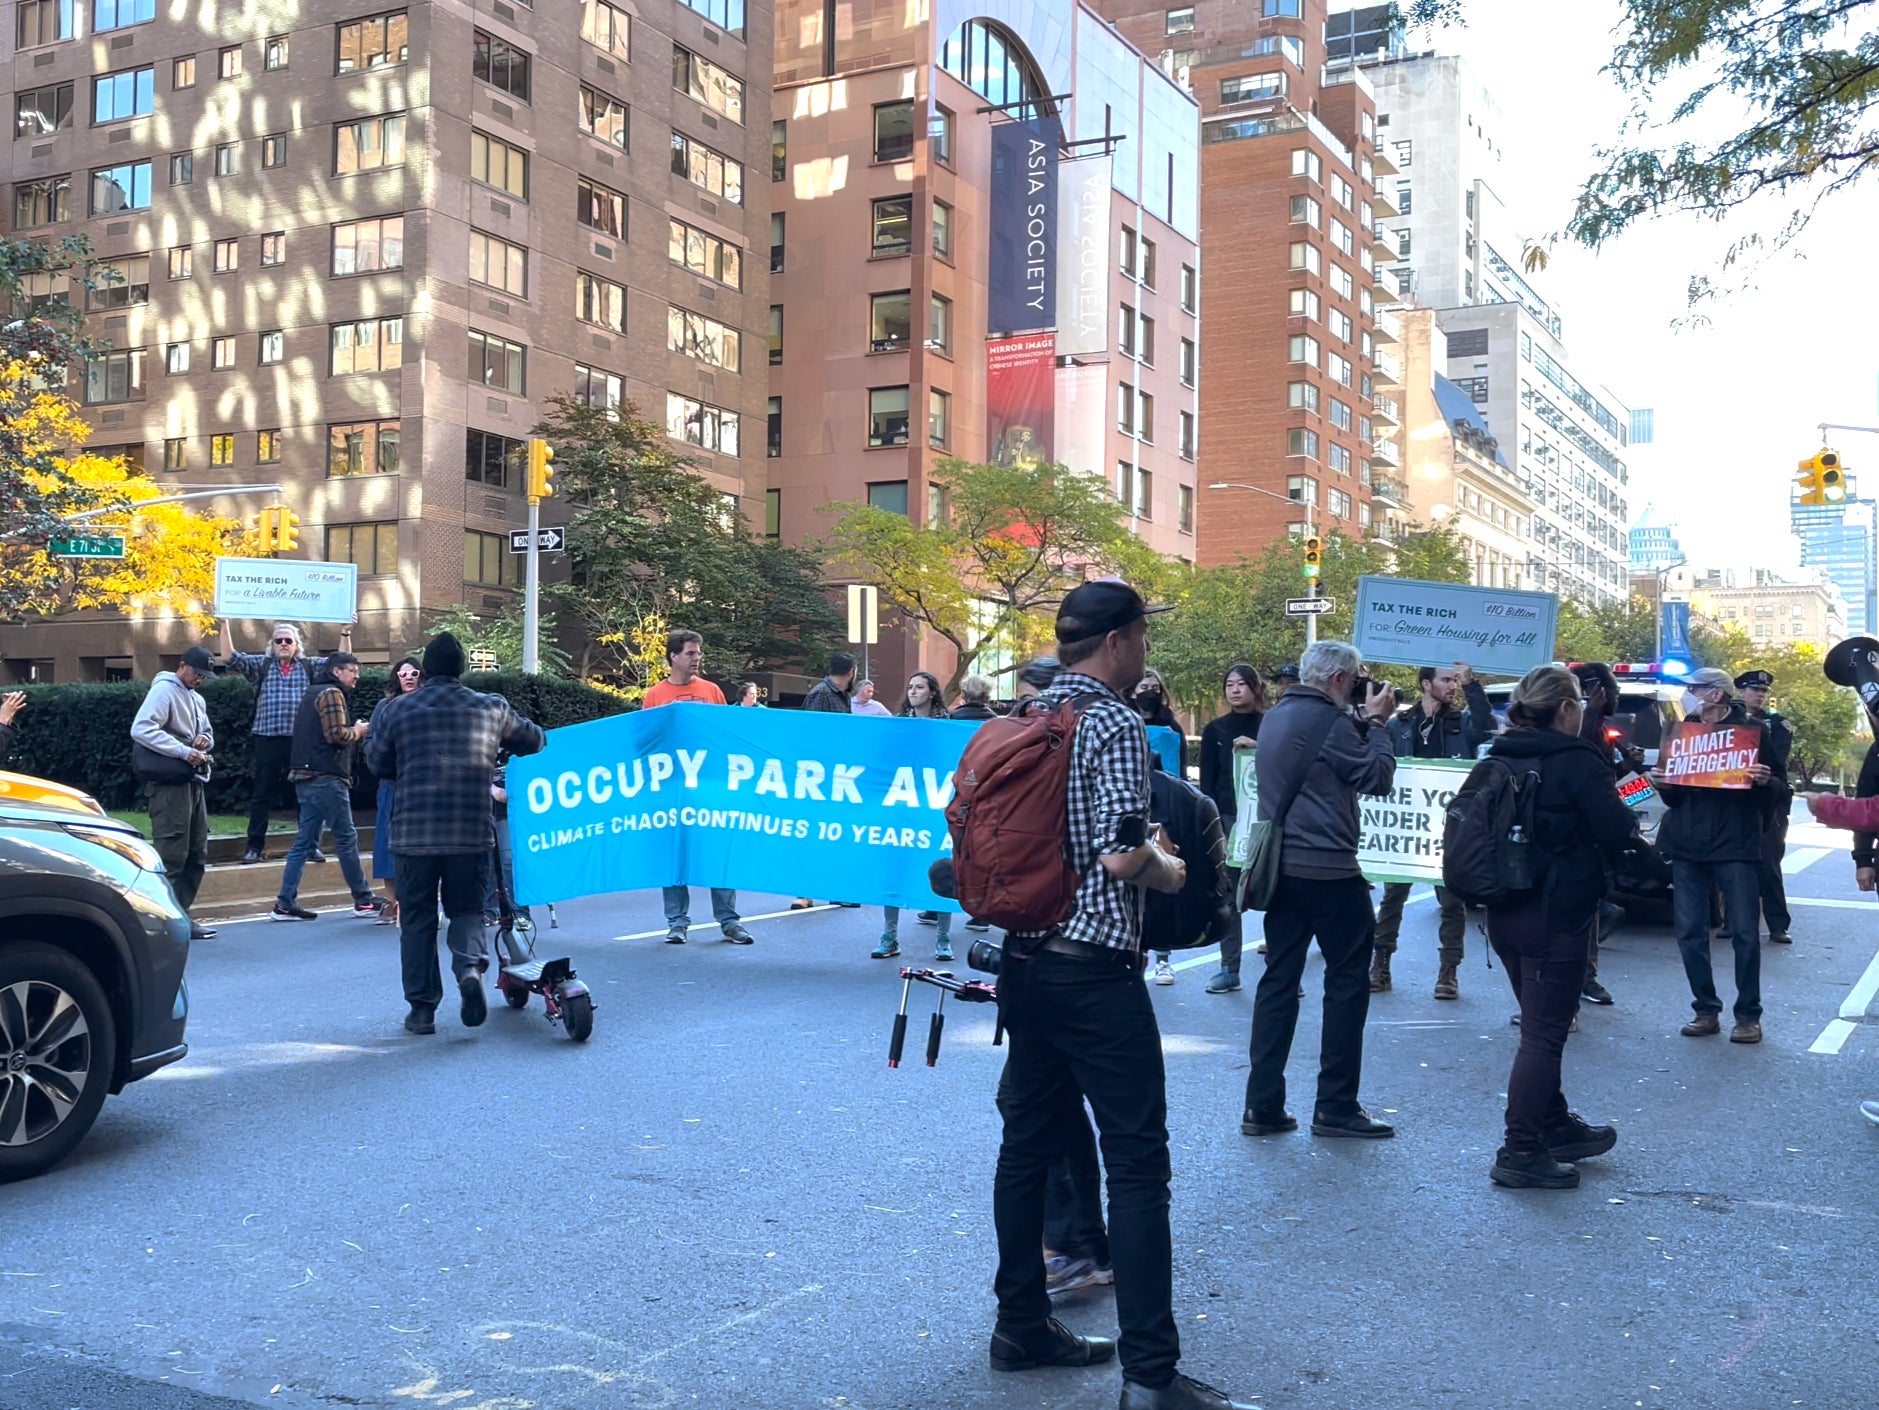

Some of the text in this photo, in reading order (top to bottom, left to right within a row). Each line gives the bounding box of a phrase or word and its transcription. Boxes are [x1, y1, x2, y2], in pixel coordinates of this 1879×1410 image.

[1026, 138, 1046, 311] ASIA SOCIETY
[989, 339, 1054, 355] MIRROR IMAGE
[70, 540, 76, 553] E
[80, 540, 88, 552] 71
[539, 535, 556, 546] WAY
[225, 575, 288, 585] TAX THE RICH
[253, 586, 287, 598] Livable
[1313, 601, 1328, 609] WAY
[1371, 602, 1457, 619] TAX THE RICH
[1485, 604, 1537, 619] $10 Billion
[1394, 620, 1432, 636] Green
[1436, 624, 1488, 647] Housing
[1489, 629, 1512, 647] for
[1514, 632, 1538, 646] All
[1671, 728, 1736, 758] CLIMATE
[1664, 748, 1759, 777] EMERGENCY
[527, 749, 956, 814] OCCUPY PARK AV
[527, 821, 605, 853] CLIMATE
[611, 809, 677, 834] CHAOS
[680, 806, 808, 839] CONTINUES
[818, 821, 842, 841] 10
[851, 824, 932, 849] YEARS
